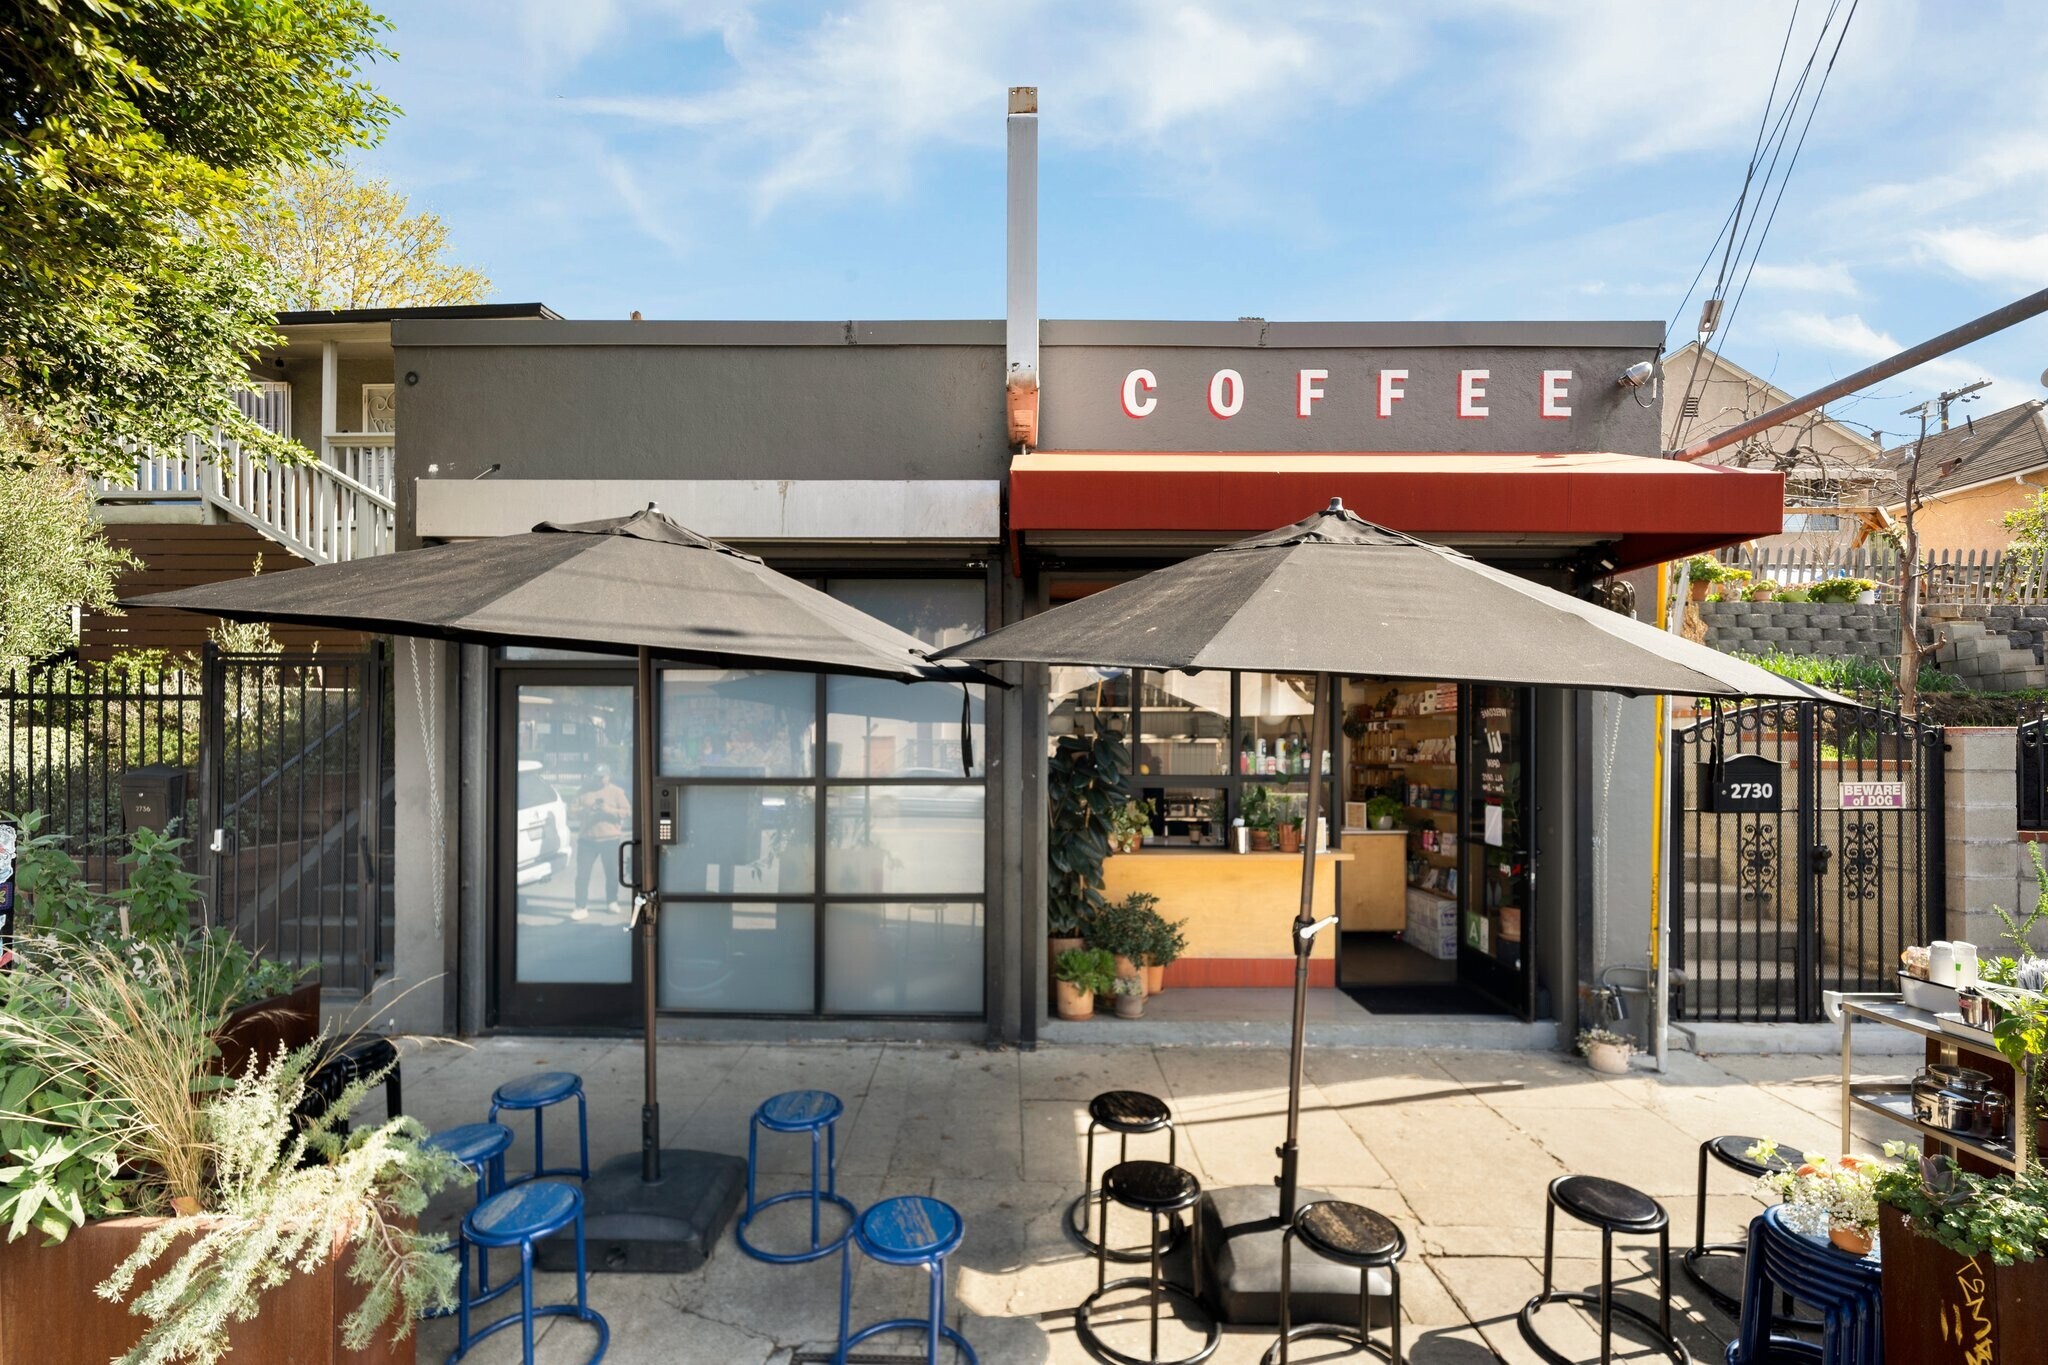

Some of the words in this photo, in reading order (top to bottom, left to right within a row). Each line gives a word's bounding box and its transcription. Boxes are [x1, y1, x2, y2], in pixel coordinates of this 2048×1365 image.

[1121, 368, 1573, 418] COFFEE
[1730, 783, 1773, 799] 2730
[1844, 785, 1902, 797] BEWARE
[1853, 797, 1866, 807] of
[1868, 797, 1894, 807] DOG
[1469, 921, 1479, 943] A
